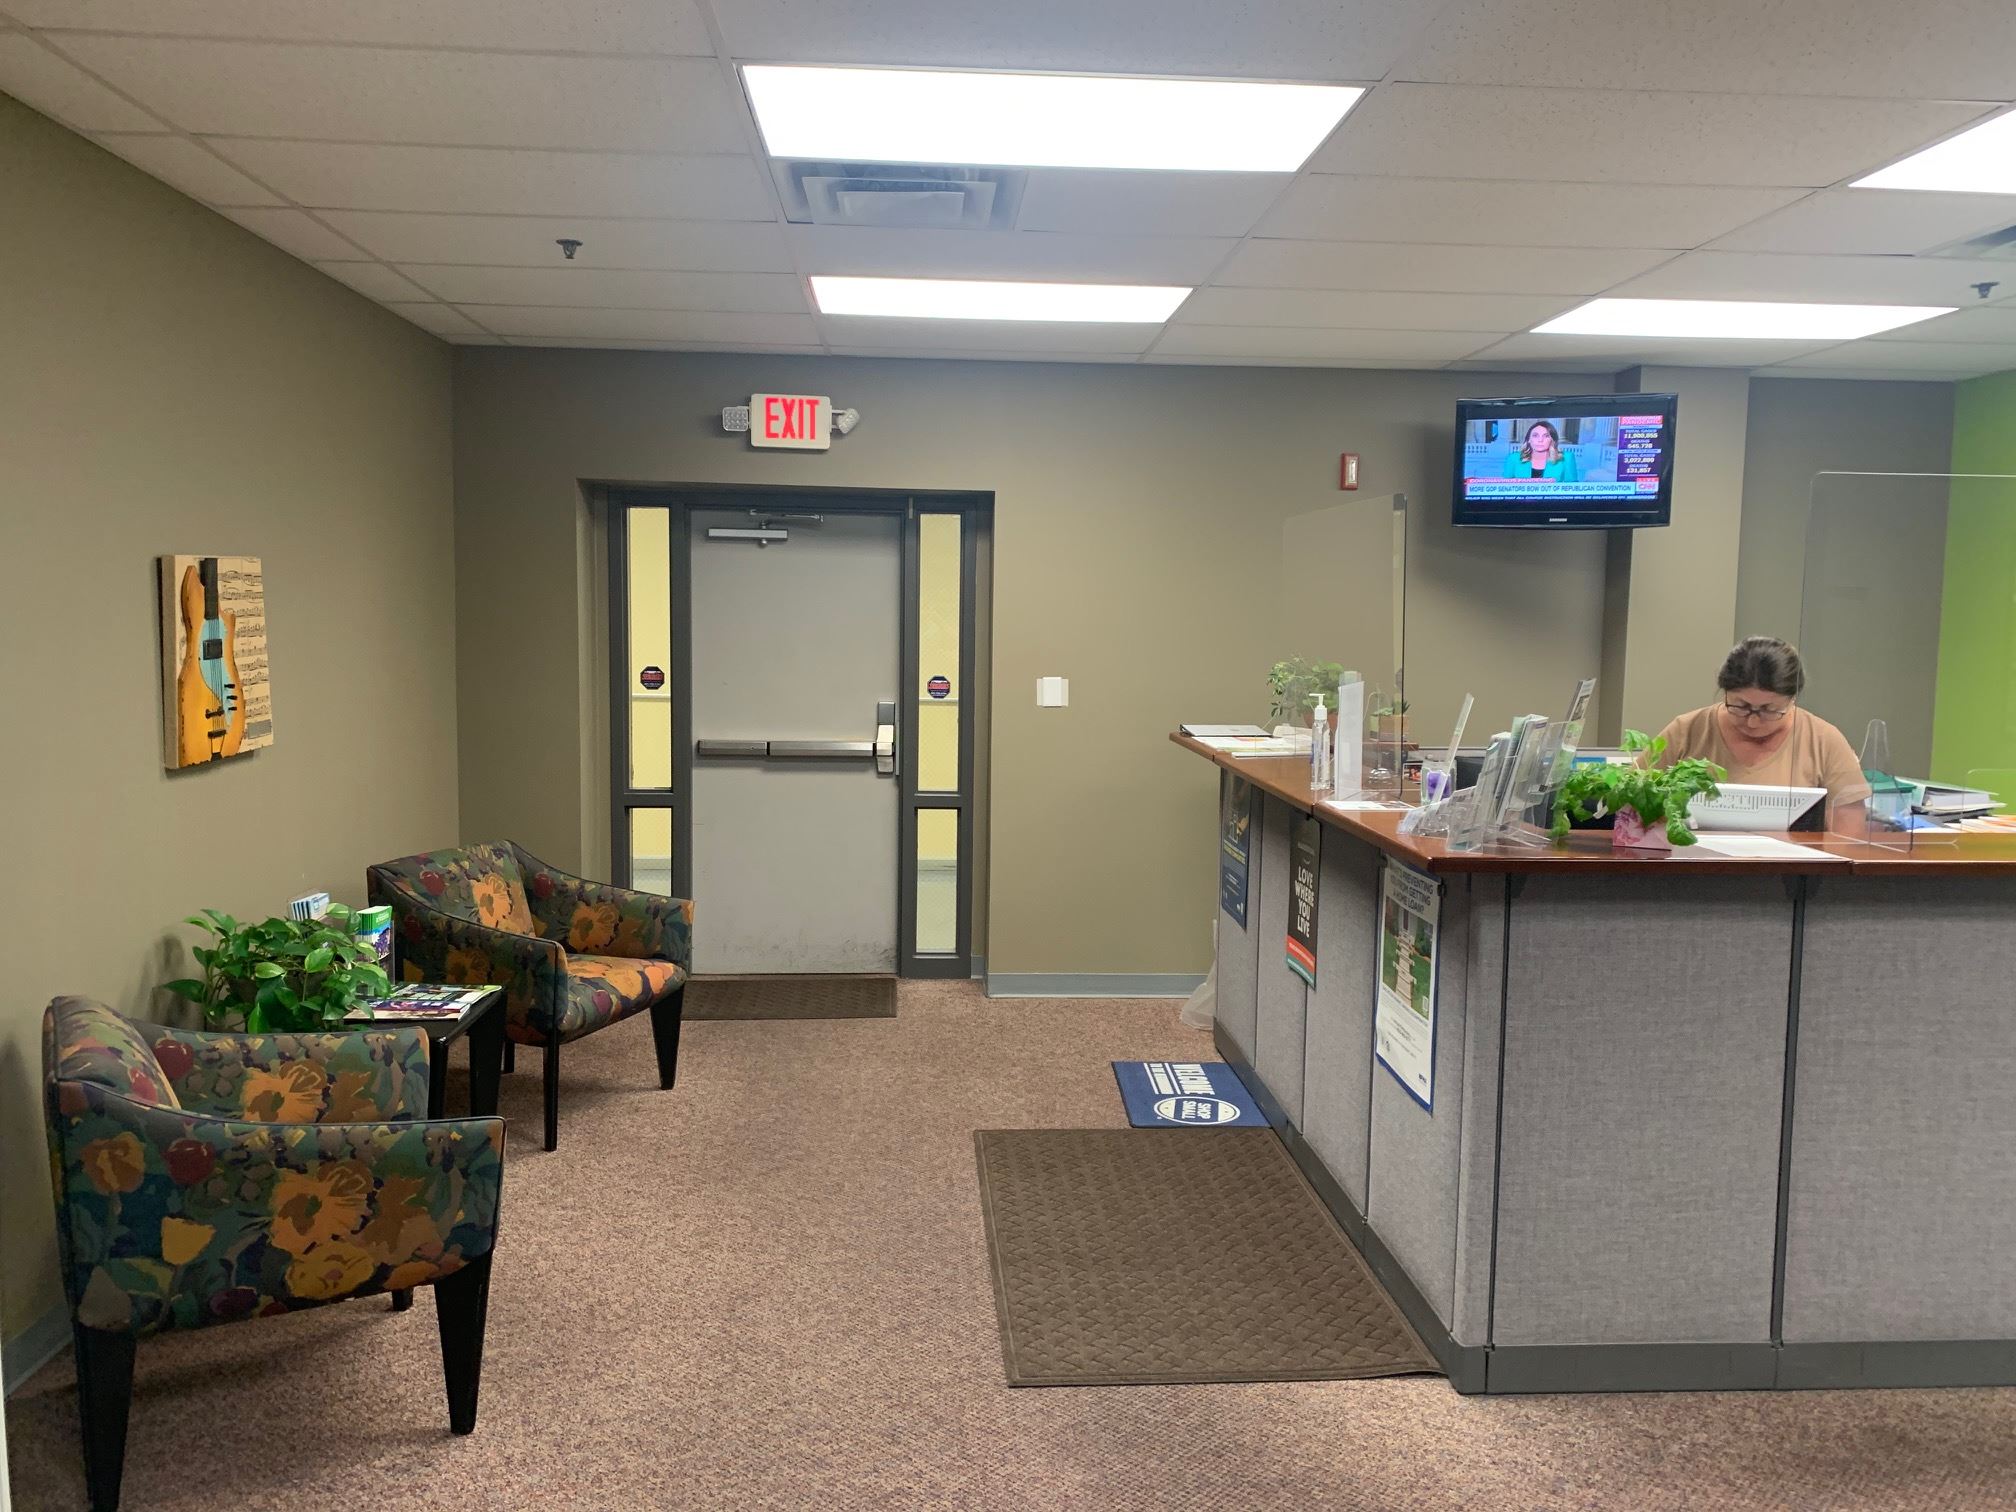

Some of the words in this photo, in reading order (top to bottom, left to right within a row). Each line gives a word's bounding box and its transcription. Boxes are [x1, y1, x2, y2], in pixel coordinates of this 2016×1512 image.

[765, 397, 820, 440] EXIT
[1298, 865, 1313, 889] LOVE
[1402, 870, 1434, 895] PREVENTING
[1294, 879, 1315, 907] WHERE
[1408, 886, 1431, 906] GETTING
[1298, 898, 1311, 921] YOU
[1297, 914, 1310, 938] LIVE
[1172, 1063, 1216, 1096] WELCOME
[1182, 1099, 1196, 1120] SMALL
[1197, 1101, 1212, 1120] SHOP
